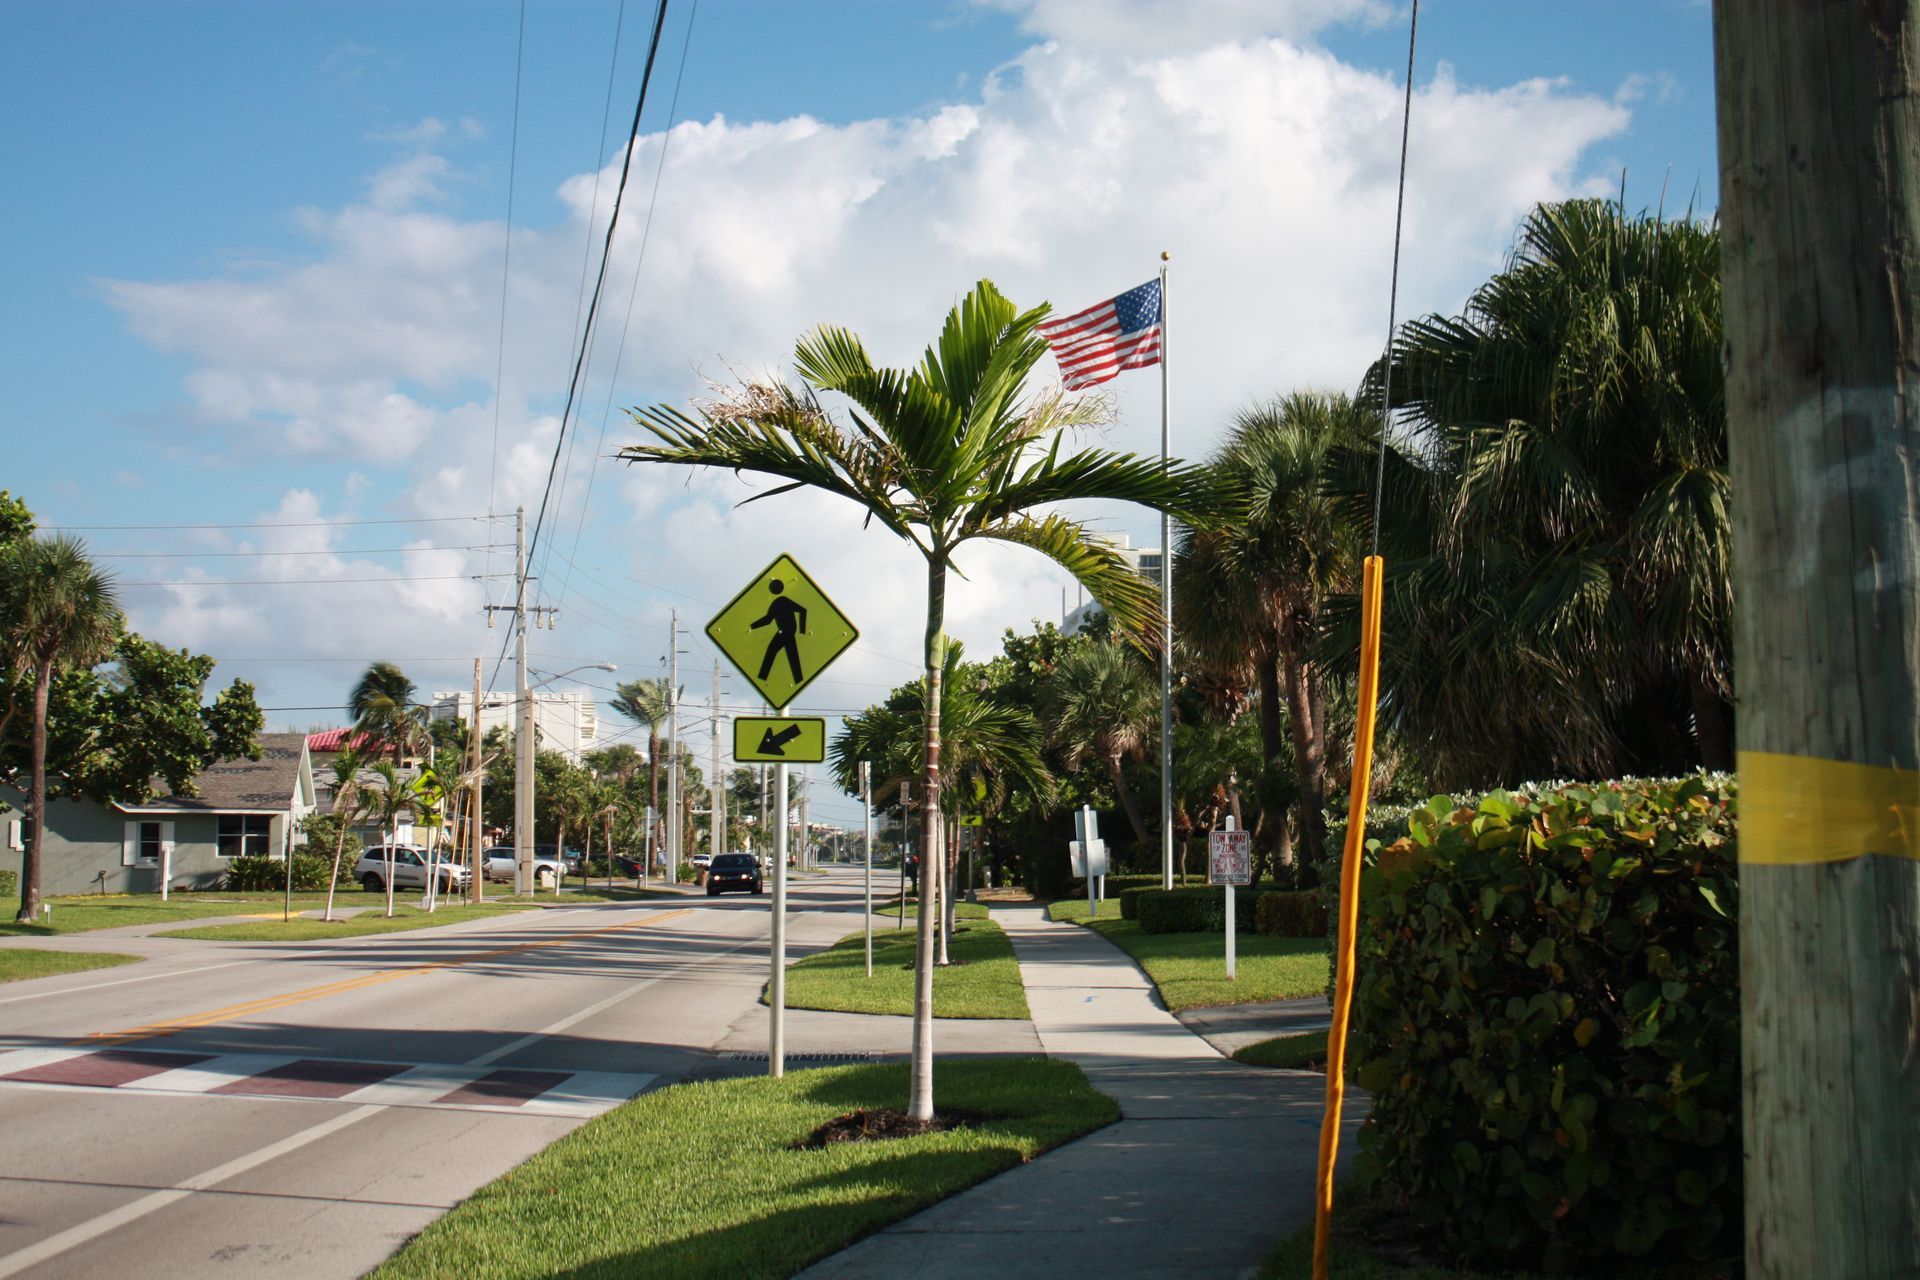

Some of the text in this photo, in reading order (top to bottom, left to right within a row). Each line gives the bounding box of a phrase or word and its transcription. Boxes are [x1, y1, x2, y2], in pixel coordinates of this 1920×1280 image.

[1212, 834, 1246, 844] TOW AWAY
[1221, 844, 1237, 853] ZONE
